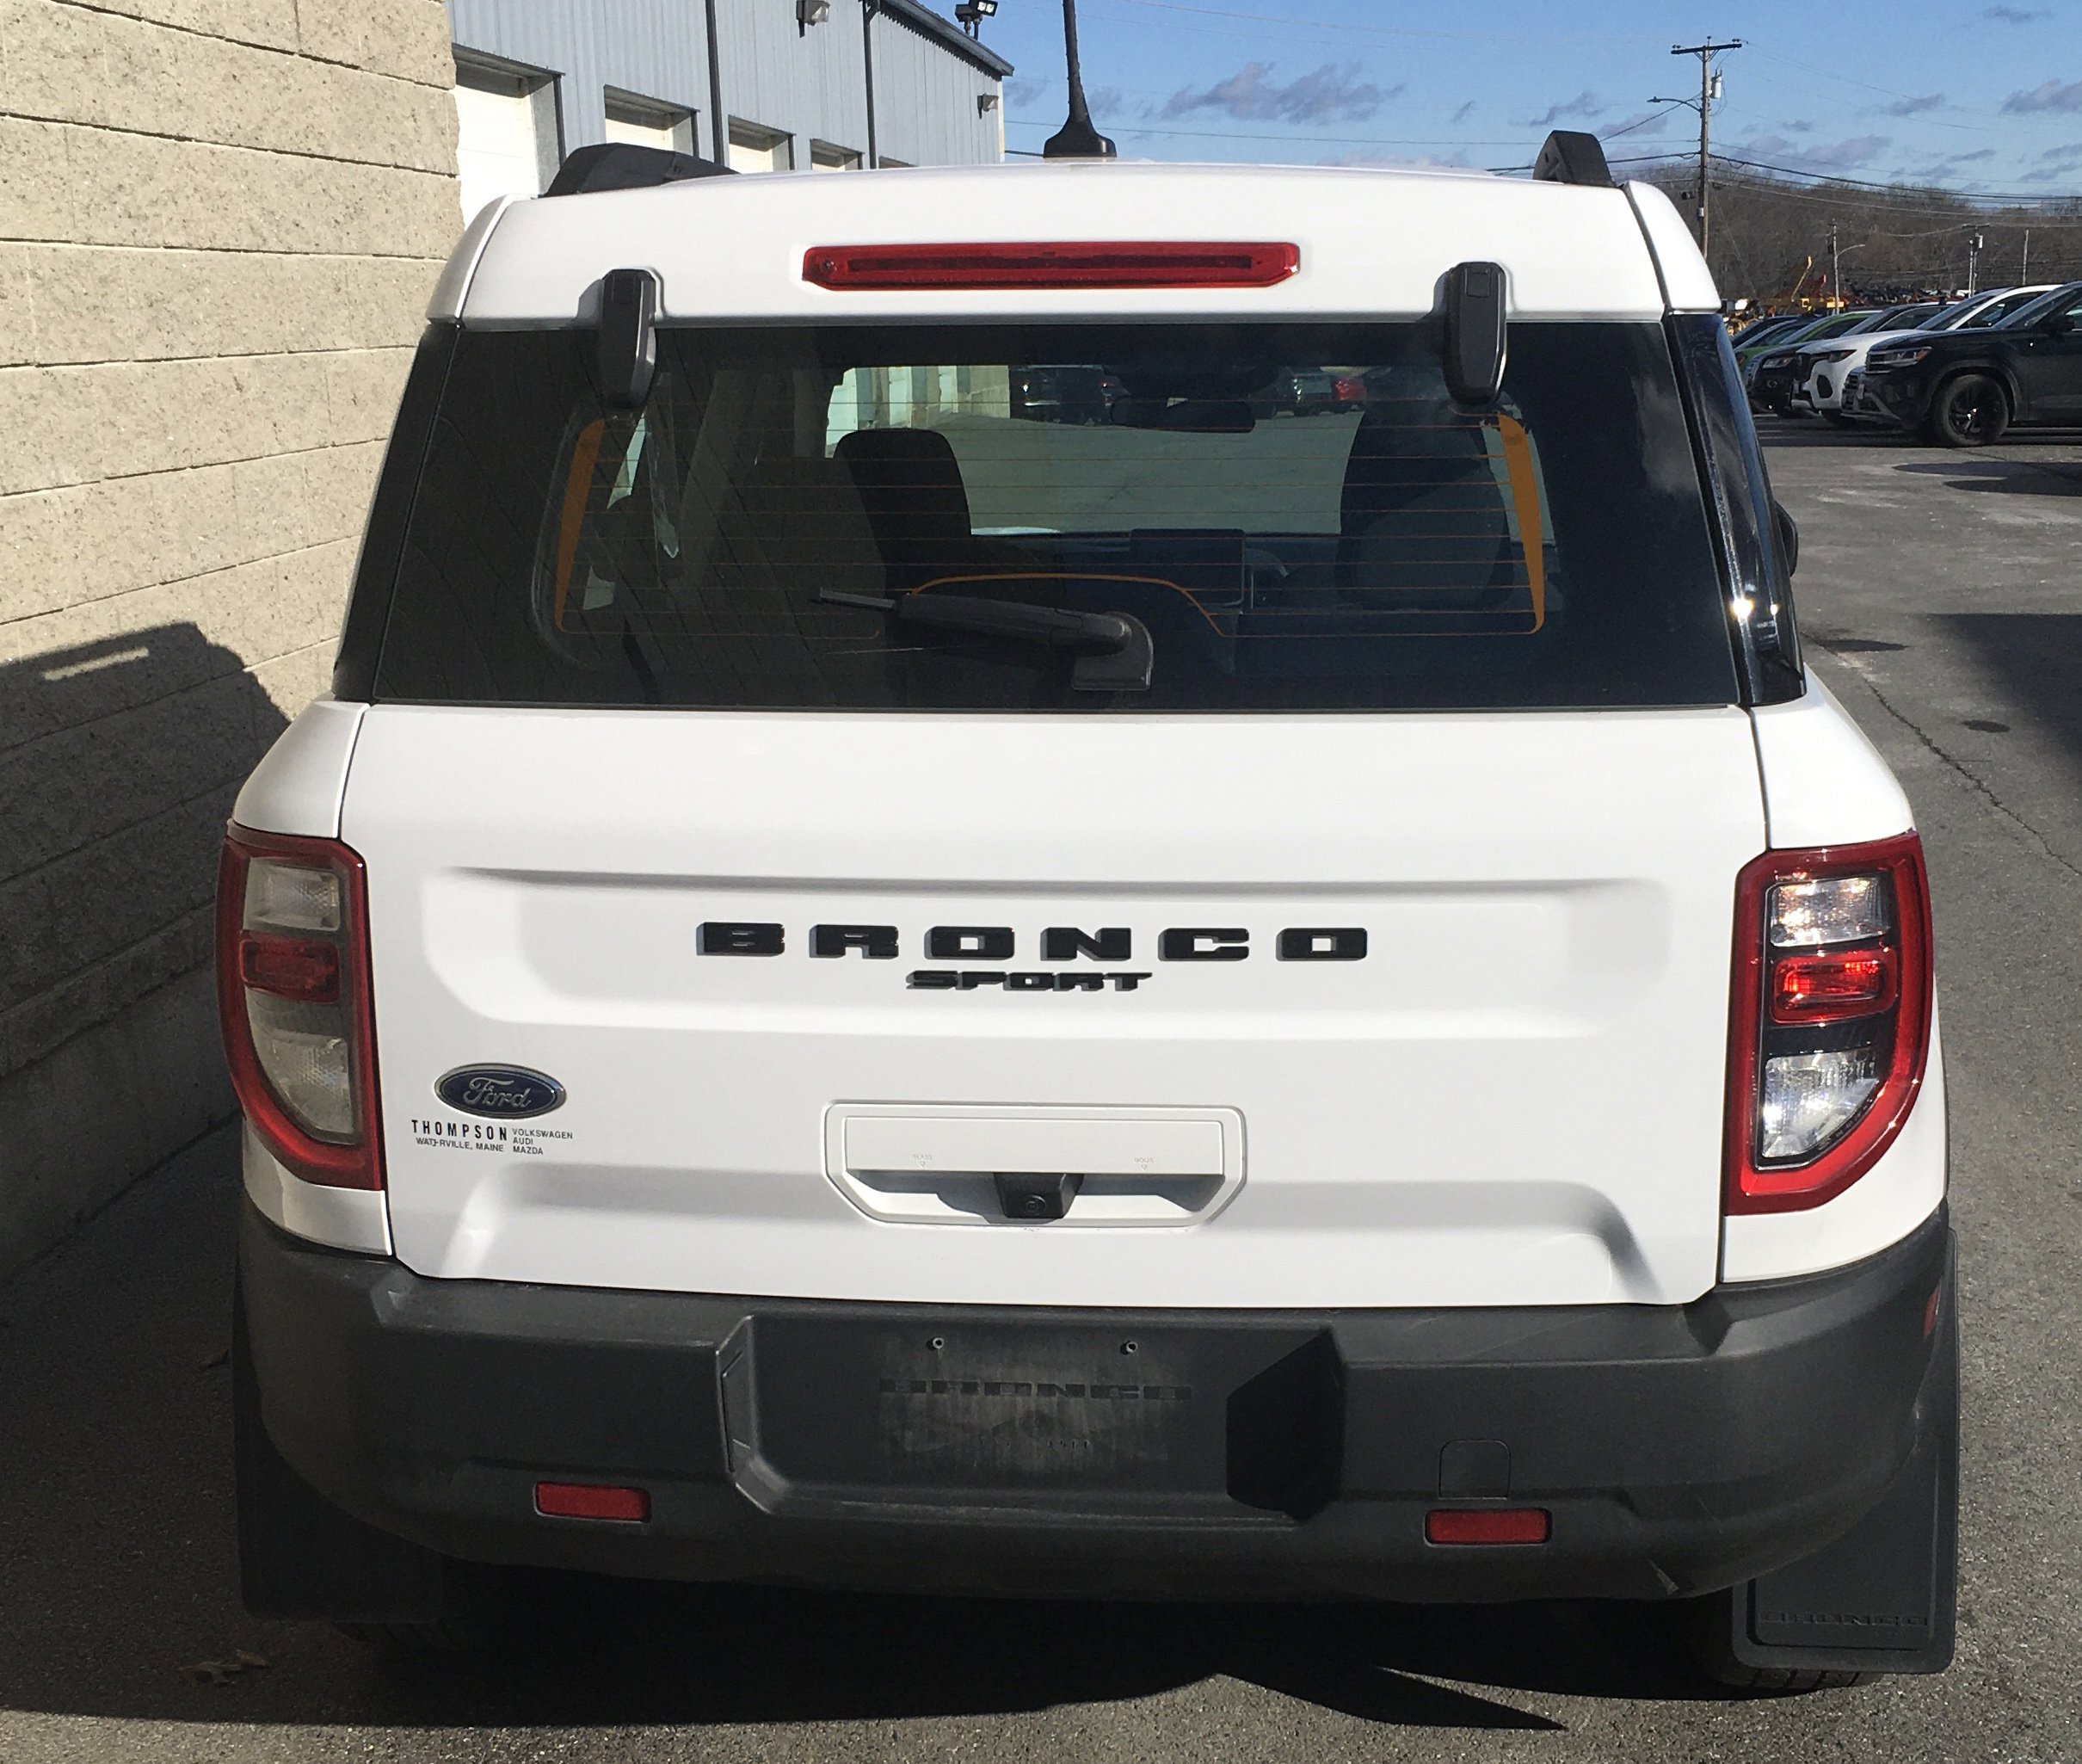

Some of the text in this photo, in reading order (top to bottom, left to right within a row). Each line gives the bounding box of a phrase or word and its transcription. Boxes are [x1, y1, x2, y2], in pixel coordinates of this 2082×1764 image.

[695, 921, 1369, 962] BRONCO
[905, 969, 1154, 992] SPORT
[462, 1076, 533, 1108] Ford
[411, 1119, 508, 1141] THOMPSON
[512, 1127, 574, 1139] VOLKSWAGEN
[475, 1142, 505, 1153] MAINE
[513, 1135, 534, 1146] AUDI
[513, 1144, 544, 1156] MAZDA
[878, 1378, 1194, 1401] BRONCO
[1758, 1611, 1928, 1627] BRONCO
